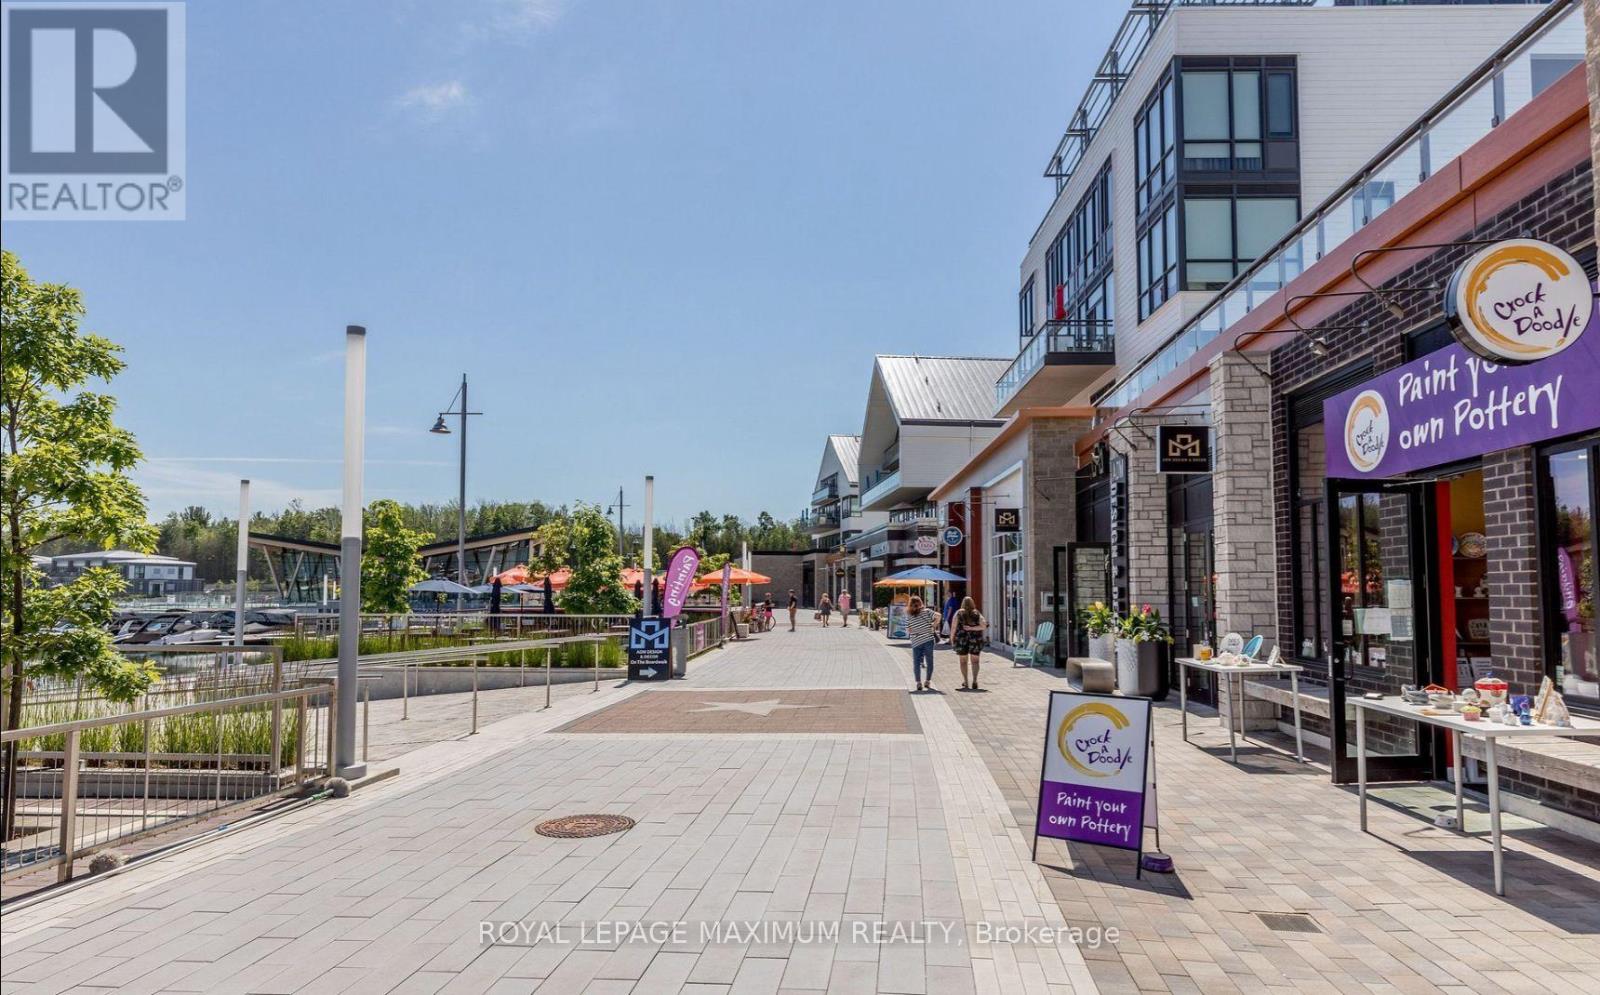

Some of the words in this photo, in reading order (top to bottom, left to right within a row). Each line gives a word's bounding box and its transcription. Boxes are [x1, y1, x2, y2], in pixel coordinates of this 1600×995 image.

[1493, 282, 1547, 320] Crock
[1533, 305, 1544, 318] A
[1513, 303, 1581, 337] Doodle
[1399, 354, 1459, 407] Paint
[1399, 417, 1444, 449] own
[1453, 374, 1563, 436] Pottery
[1074, 729, 1111, 753] Crock
[1087, 746, 1133, 770] Doodle
[1056, 792, 1092, 811] Paint
[1094, 800, 1127, 817] your
[1048, 814, 1076, 827] own
[1080, 815, 1132, 843] Pottery
